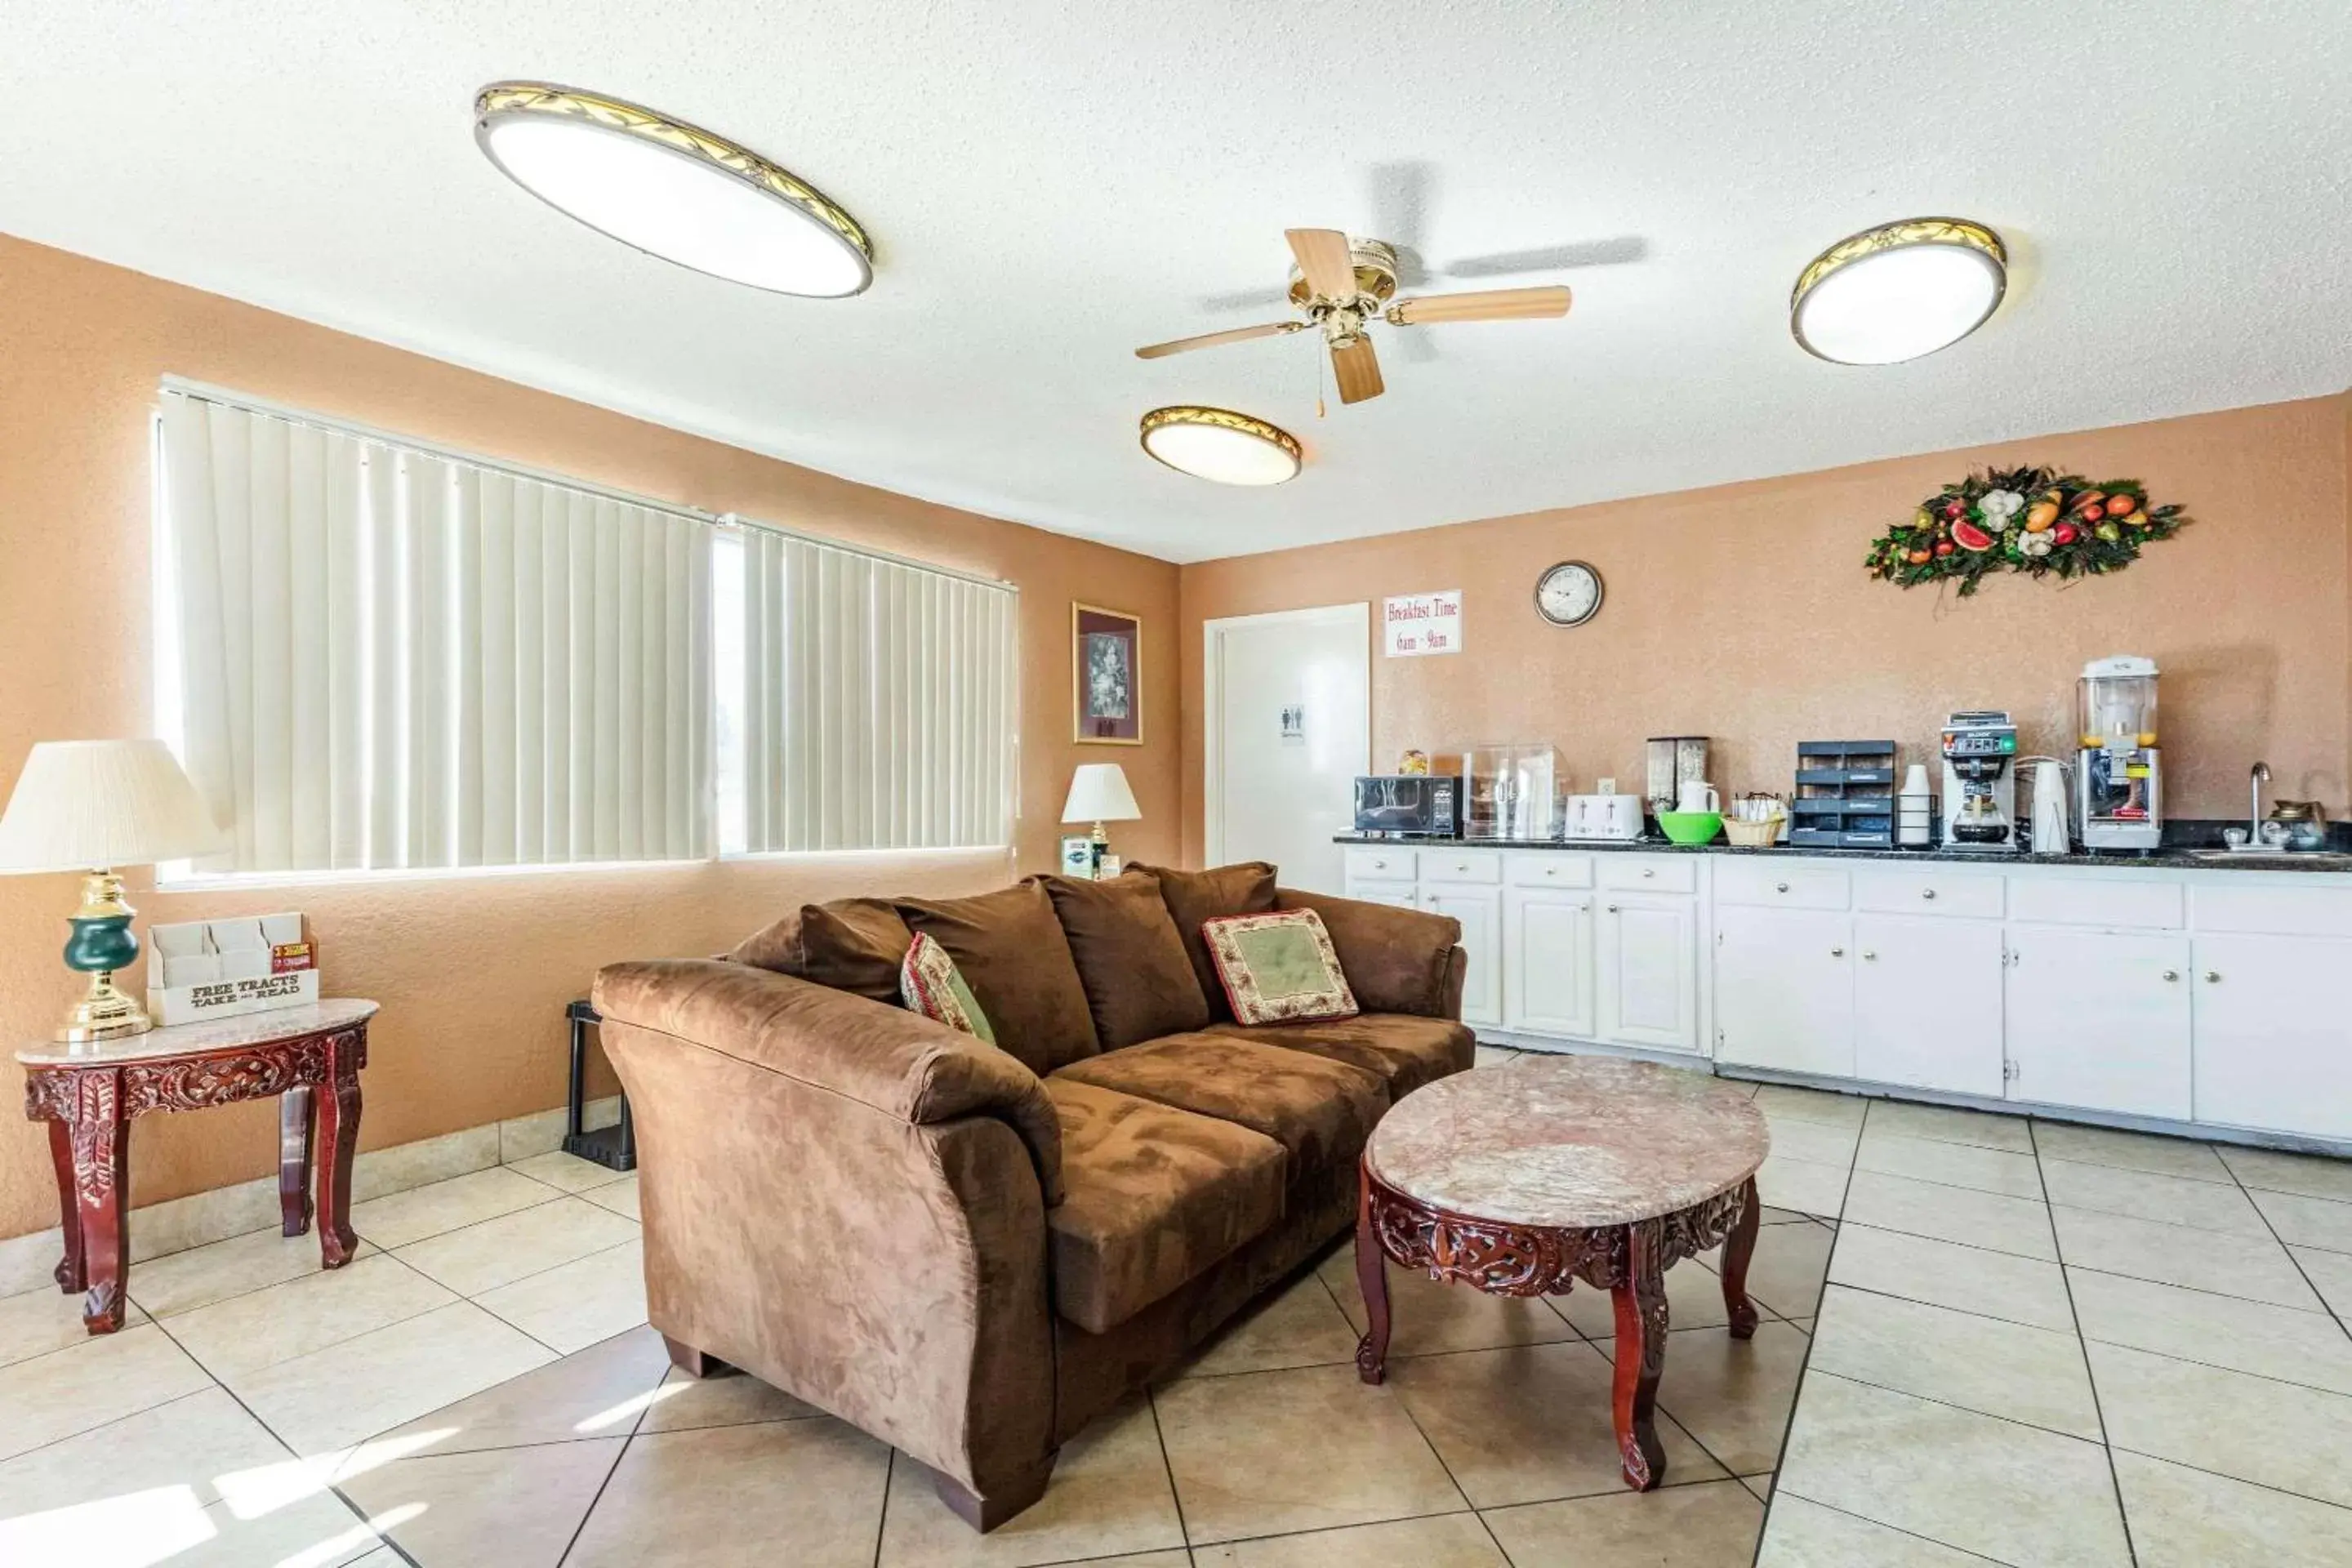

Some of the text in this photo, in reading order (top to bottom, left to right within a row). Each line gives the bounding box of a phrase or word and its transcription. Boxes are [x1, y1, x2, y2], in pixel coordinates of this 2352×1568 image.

[1388, 598, 1458, 621] Breakfast Time
[1396, 632, 1417, 650] 6am
[1428, 629, 1446, 648] 9am
[190, 994, 238, 1008] TAKE
[256, 986, 301, 999] READ
[192, 983, 233, 998] FREE
[238, 974, 299, 991] TRACTS
